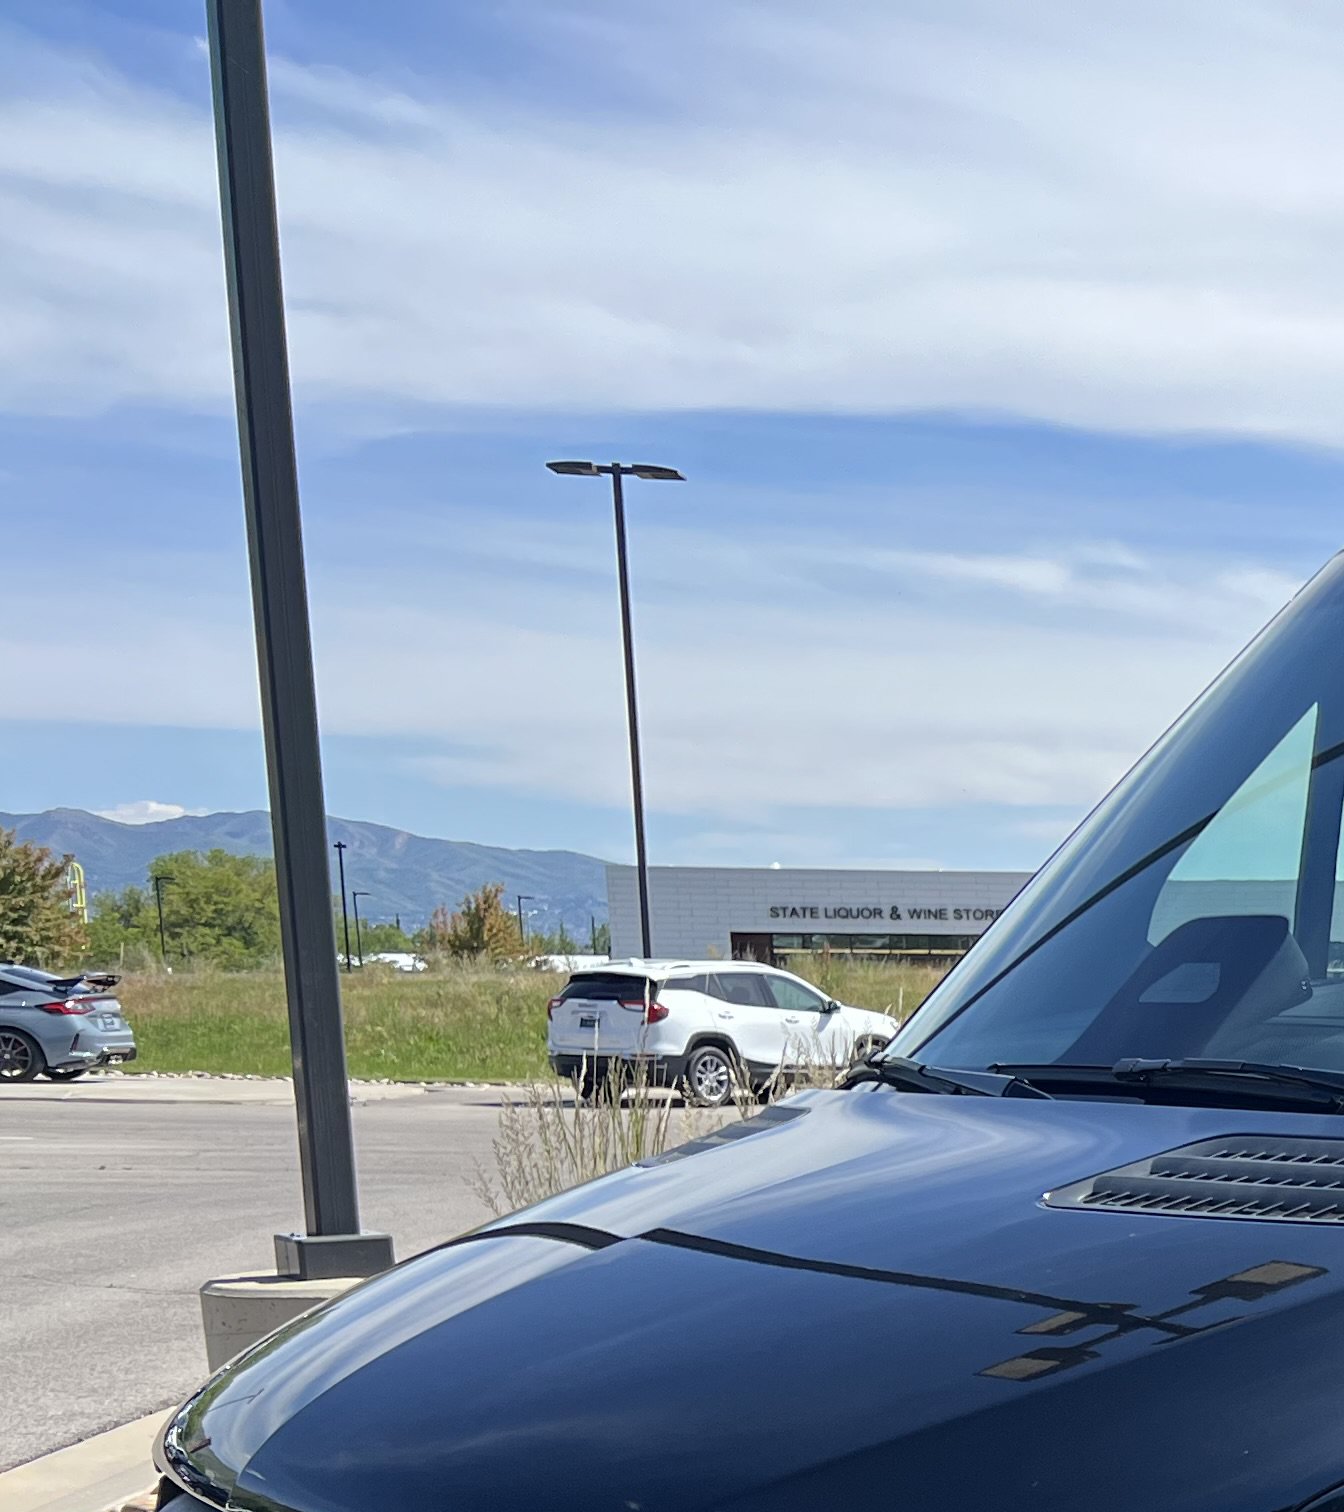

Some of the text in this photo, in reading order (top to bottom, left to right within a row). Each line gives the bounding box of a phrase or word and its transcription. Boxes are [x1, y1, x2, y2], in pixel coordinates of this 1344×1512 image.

[769, 906, 820, 919] STATE
[825, 906, 884, 920] LIQUOR
[889, 905, 901, 921] &
[908, 907, 948, 921] WINE
